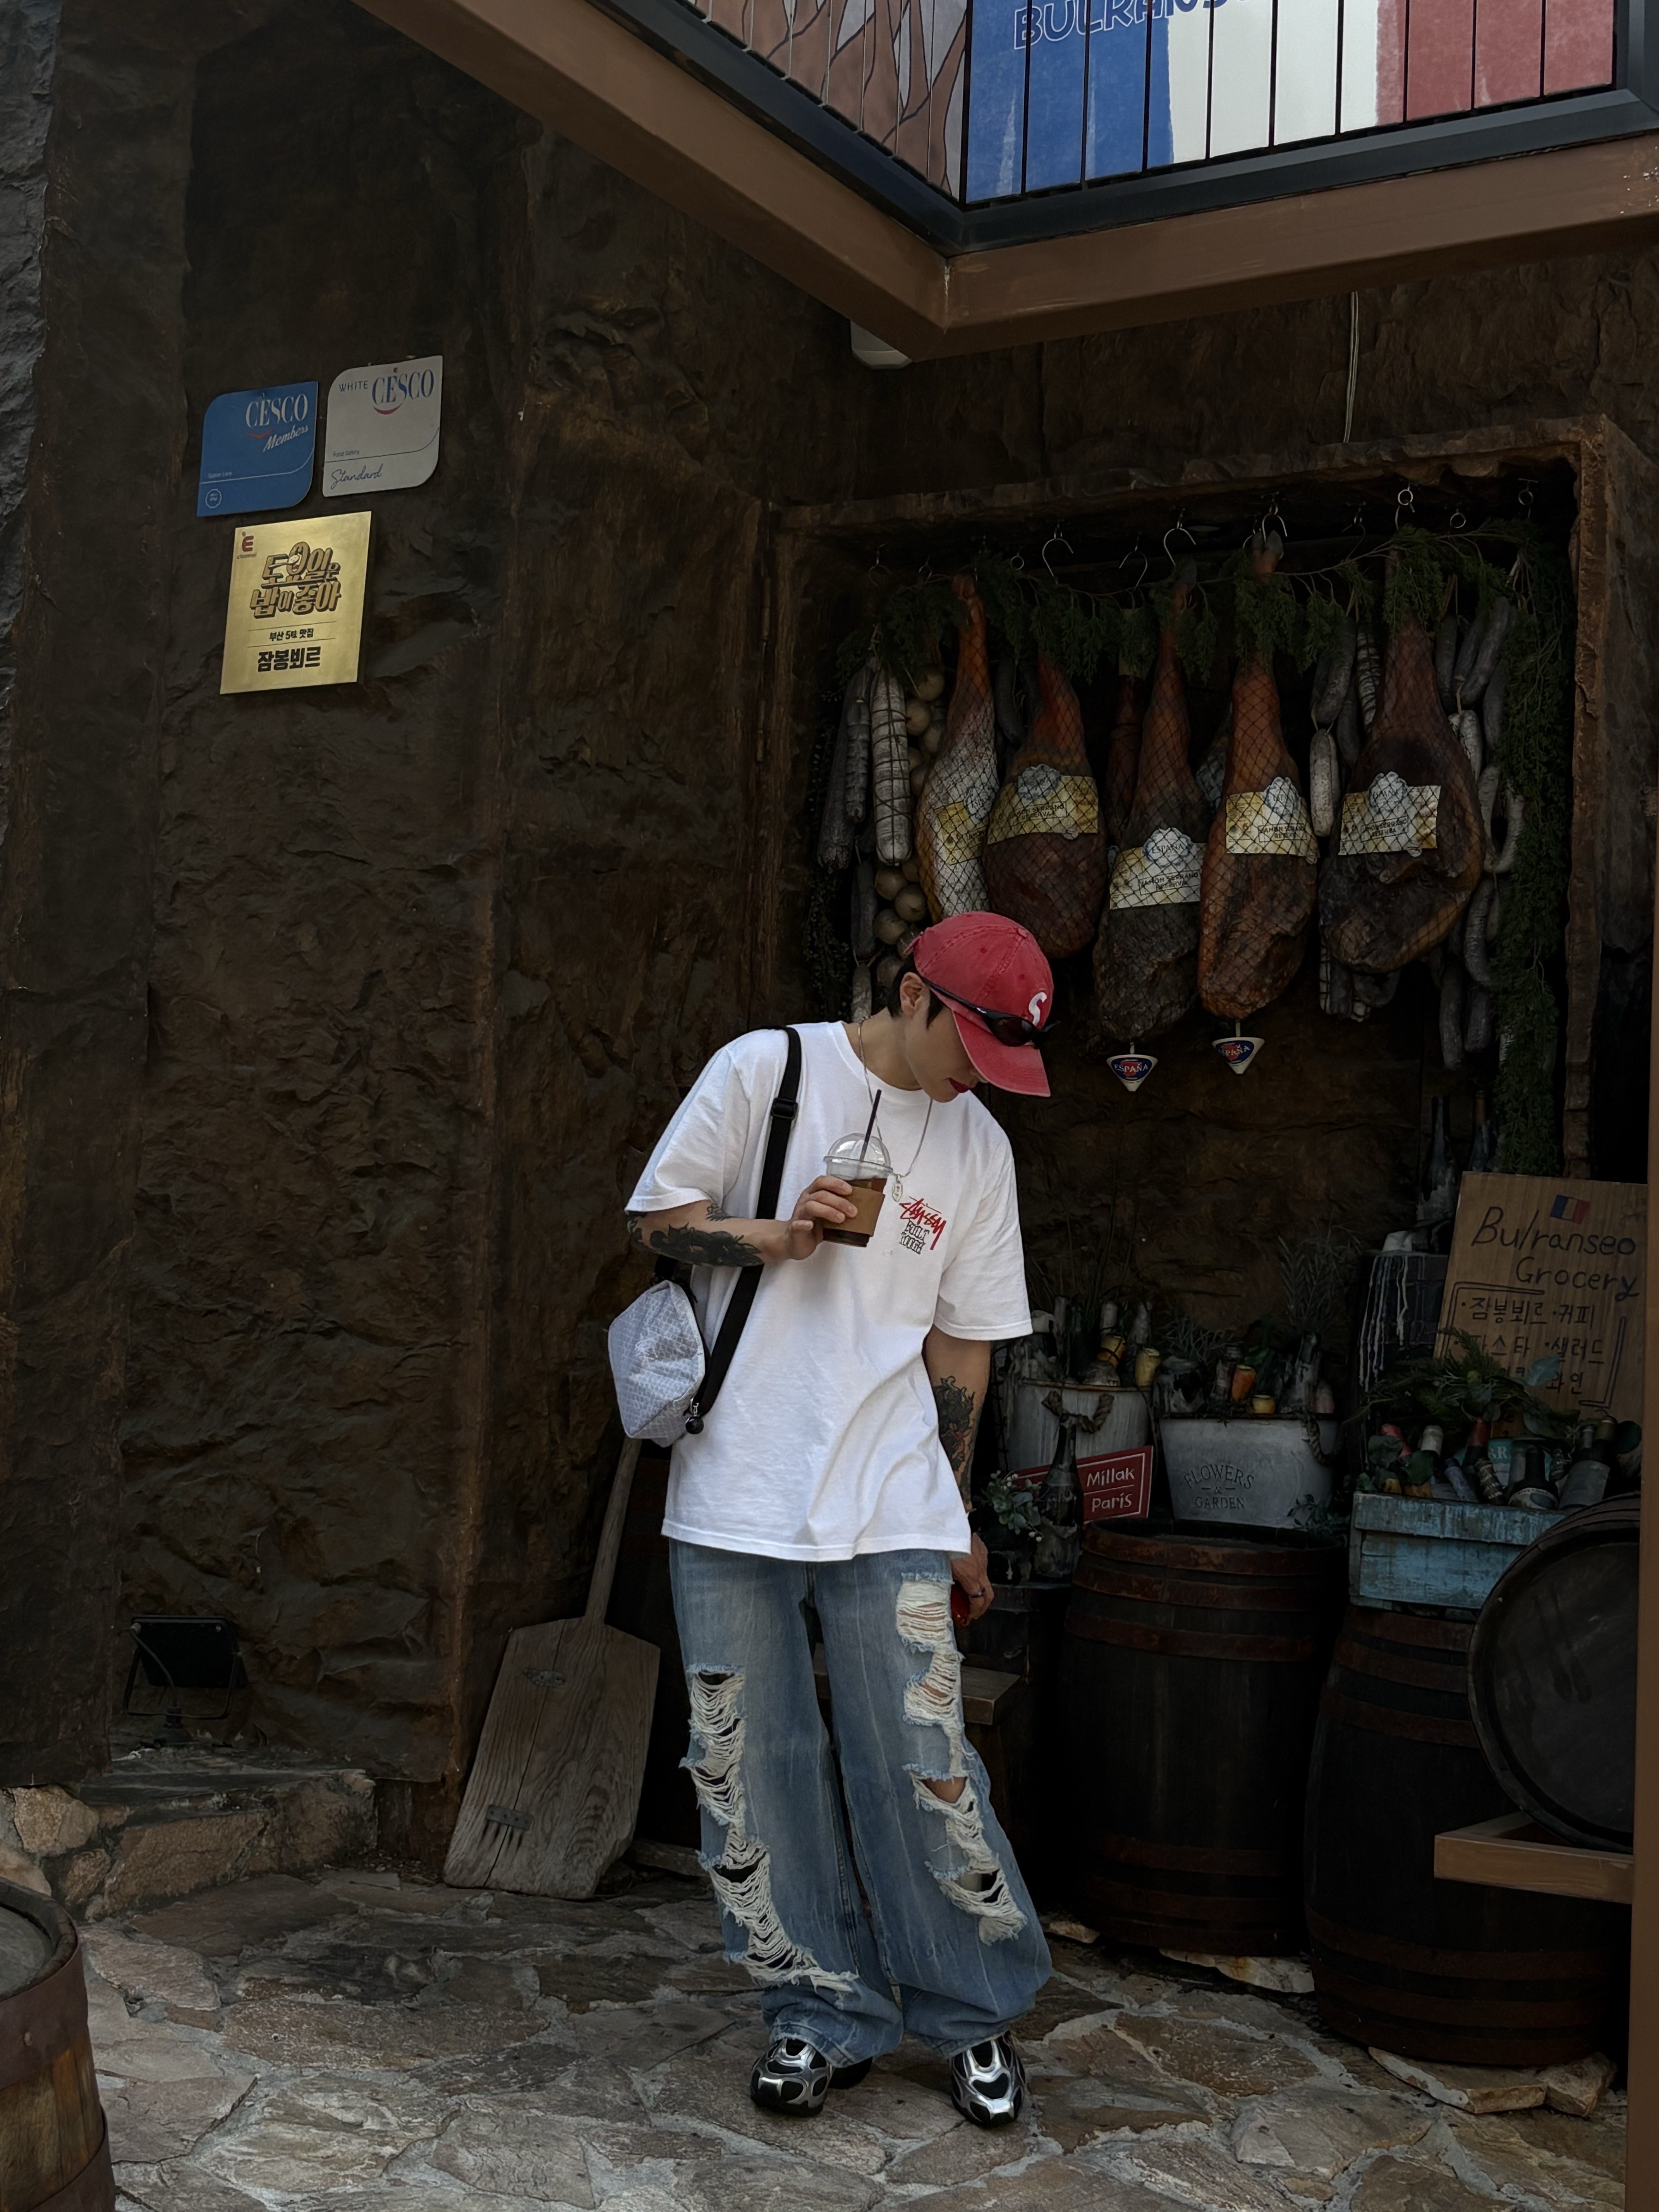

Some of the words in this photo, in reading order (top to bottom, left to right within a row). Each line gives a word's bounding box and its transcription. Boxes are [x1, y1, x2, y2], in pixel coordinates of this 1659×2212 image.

[339, 380, 368, 392] WHITE
[372, 369, 434, 405] CESCO
[246, 393, 308, 428] CESCO
[262, 425, 309, 453] Members
[331, 463, 383, 490] Standard
[269, 631, 284, 641] 부산
[299, 628, 314, 638] 맛집
[258, 646, 321, 672] 잠봉뵈르
[1471, 1206, 1636, 1256] Bulranseo
[1516, 1256, 1640, 1302] Grocery
[1559, 1304, 1595, 1330] 커피
[1545, 1372, 1583, 1395] 와인
[1184, 1464, 1254, 1489] FLOWERS
[1195, 1496, 1245, 1509] GARDEN
